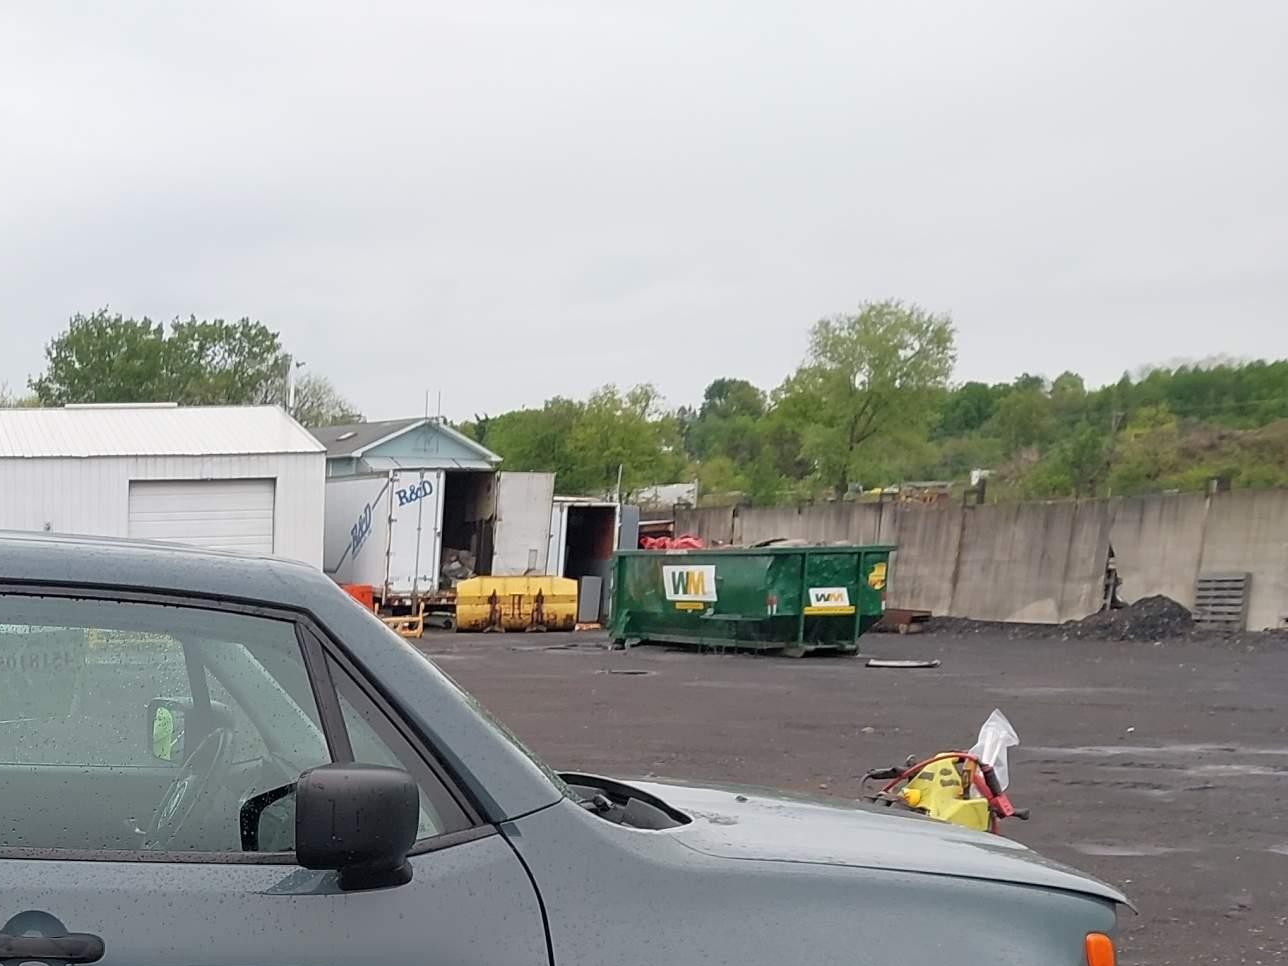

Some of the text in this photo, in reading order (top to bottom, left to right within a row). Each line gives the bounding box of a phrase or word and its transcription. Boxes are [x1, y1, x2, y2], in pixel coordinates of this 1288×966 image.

[395, 479, 434, 506] R&D
[671, 570, 706, 596] WM
[815, 592, 845, 602] WM
